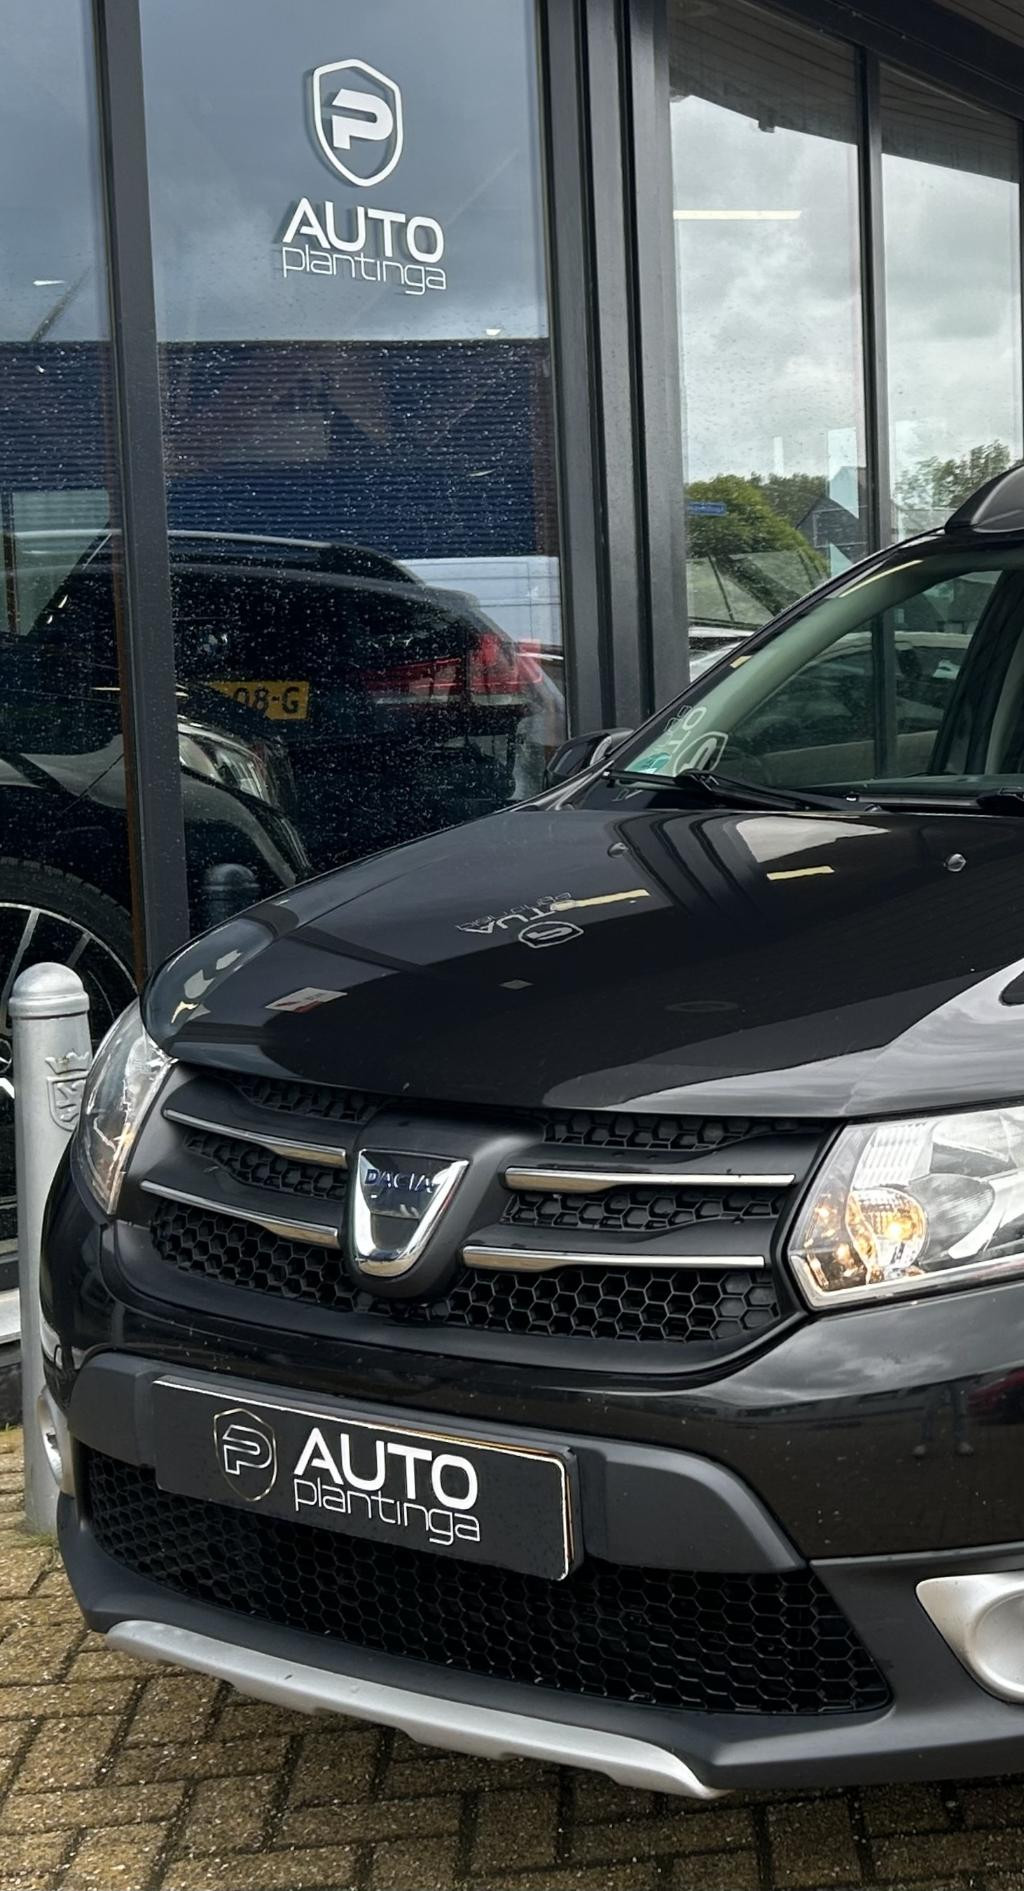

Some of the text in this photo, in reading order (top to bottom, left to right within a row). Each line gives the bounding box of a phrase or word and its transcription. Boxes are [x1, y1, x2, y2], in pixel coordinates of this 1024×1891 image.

[282, 197, 445, 264] AUTO
[282, 244, 447, 296] plantinga
[365, 1168, 434, 1194] DACIA
[293, 1427, 479, 1511] AUTO
[293, 1477, 481, 1546] plantinga
